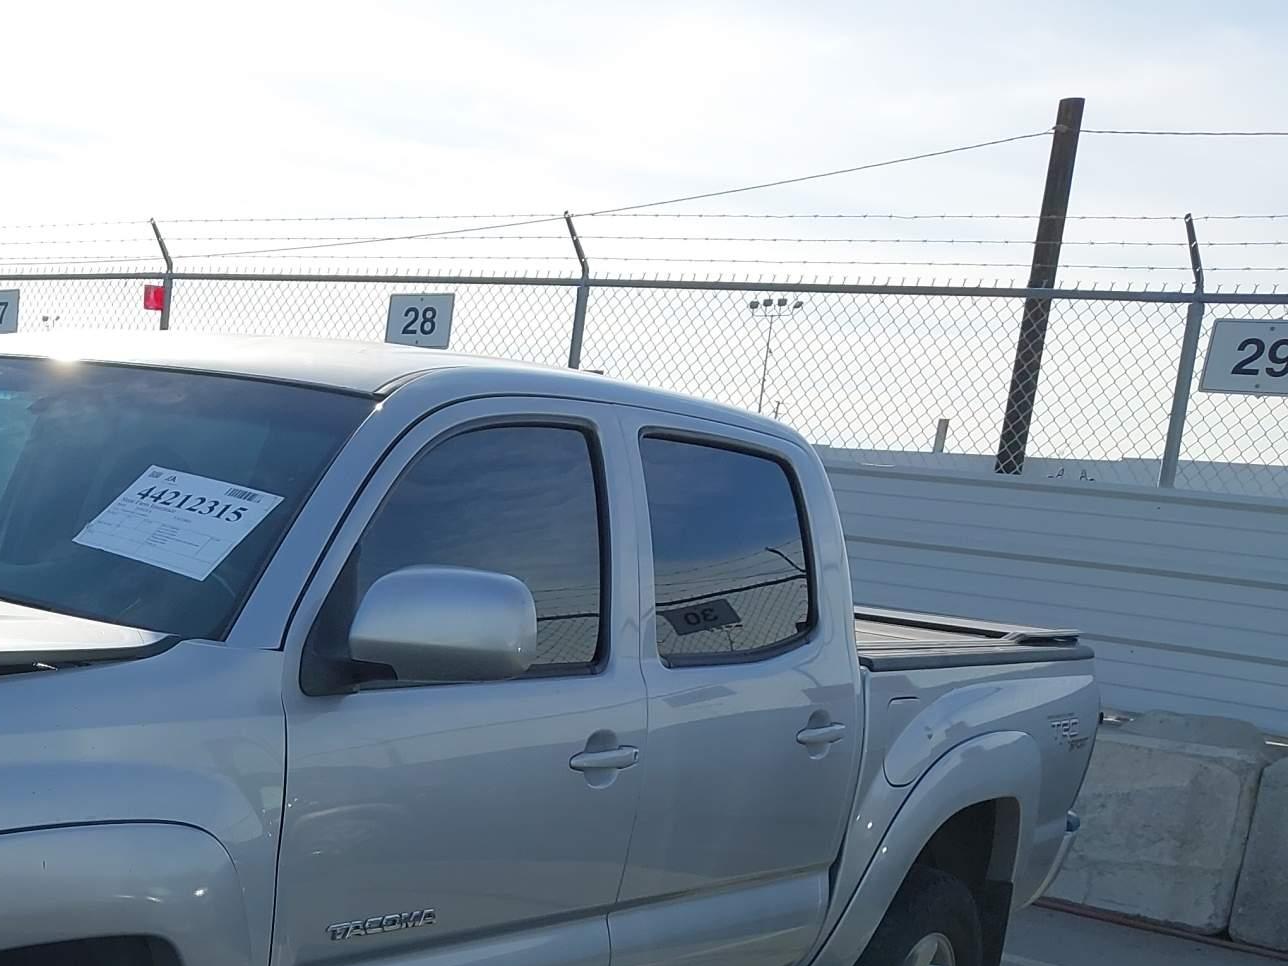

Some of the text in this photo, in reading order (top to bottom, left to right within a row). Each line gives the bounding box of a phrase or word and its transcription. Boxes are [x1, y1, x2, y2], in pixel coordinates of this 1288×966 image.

[401, 306, 437, 335] 28
[1231, 338, 1288, 378] 29
[137, 485, 249, 523] 44212315
[325, 908, 437, 940] TACOMA
